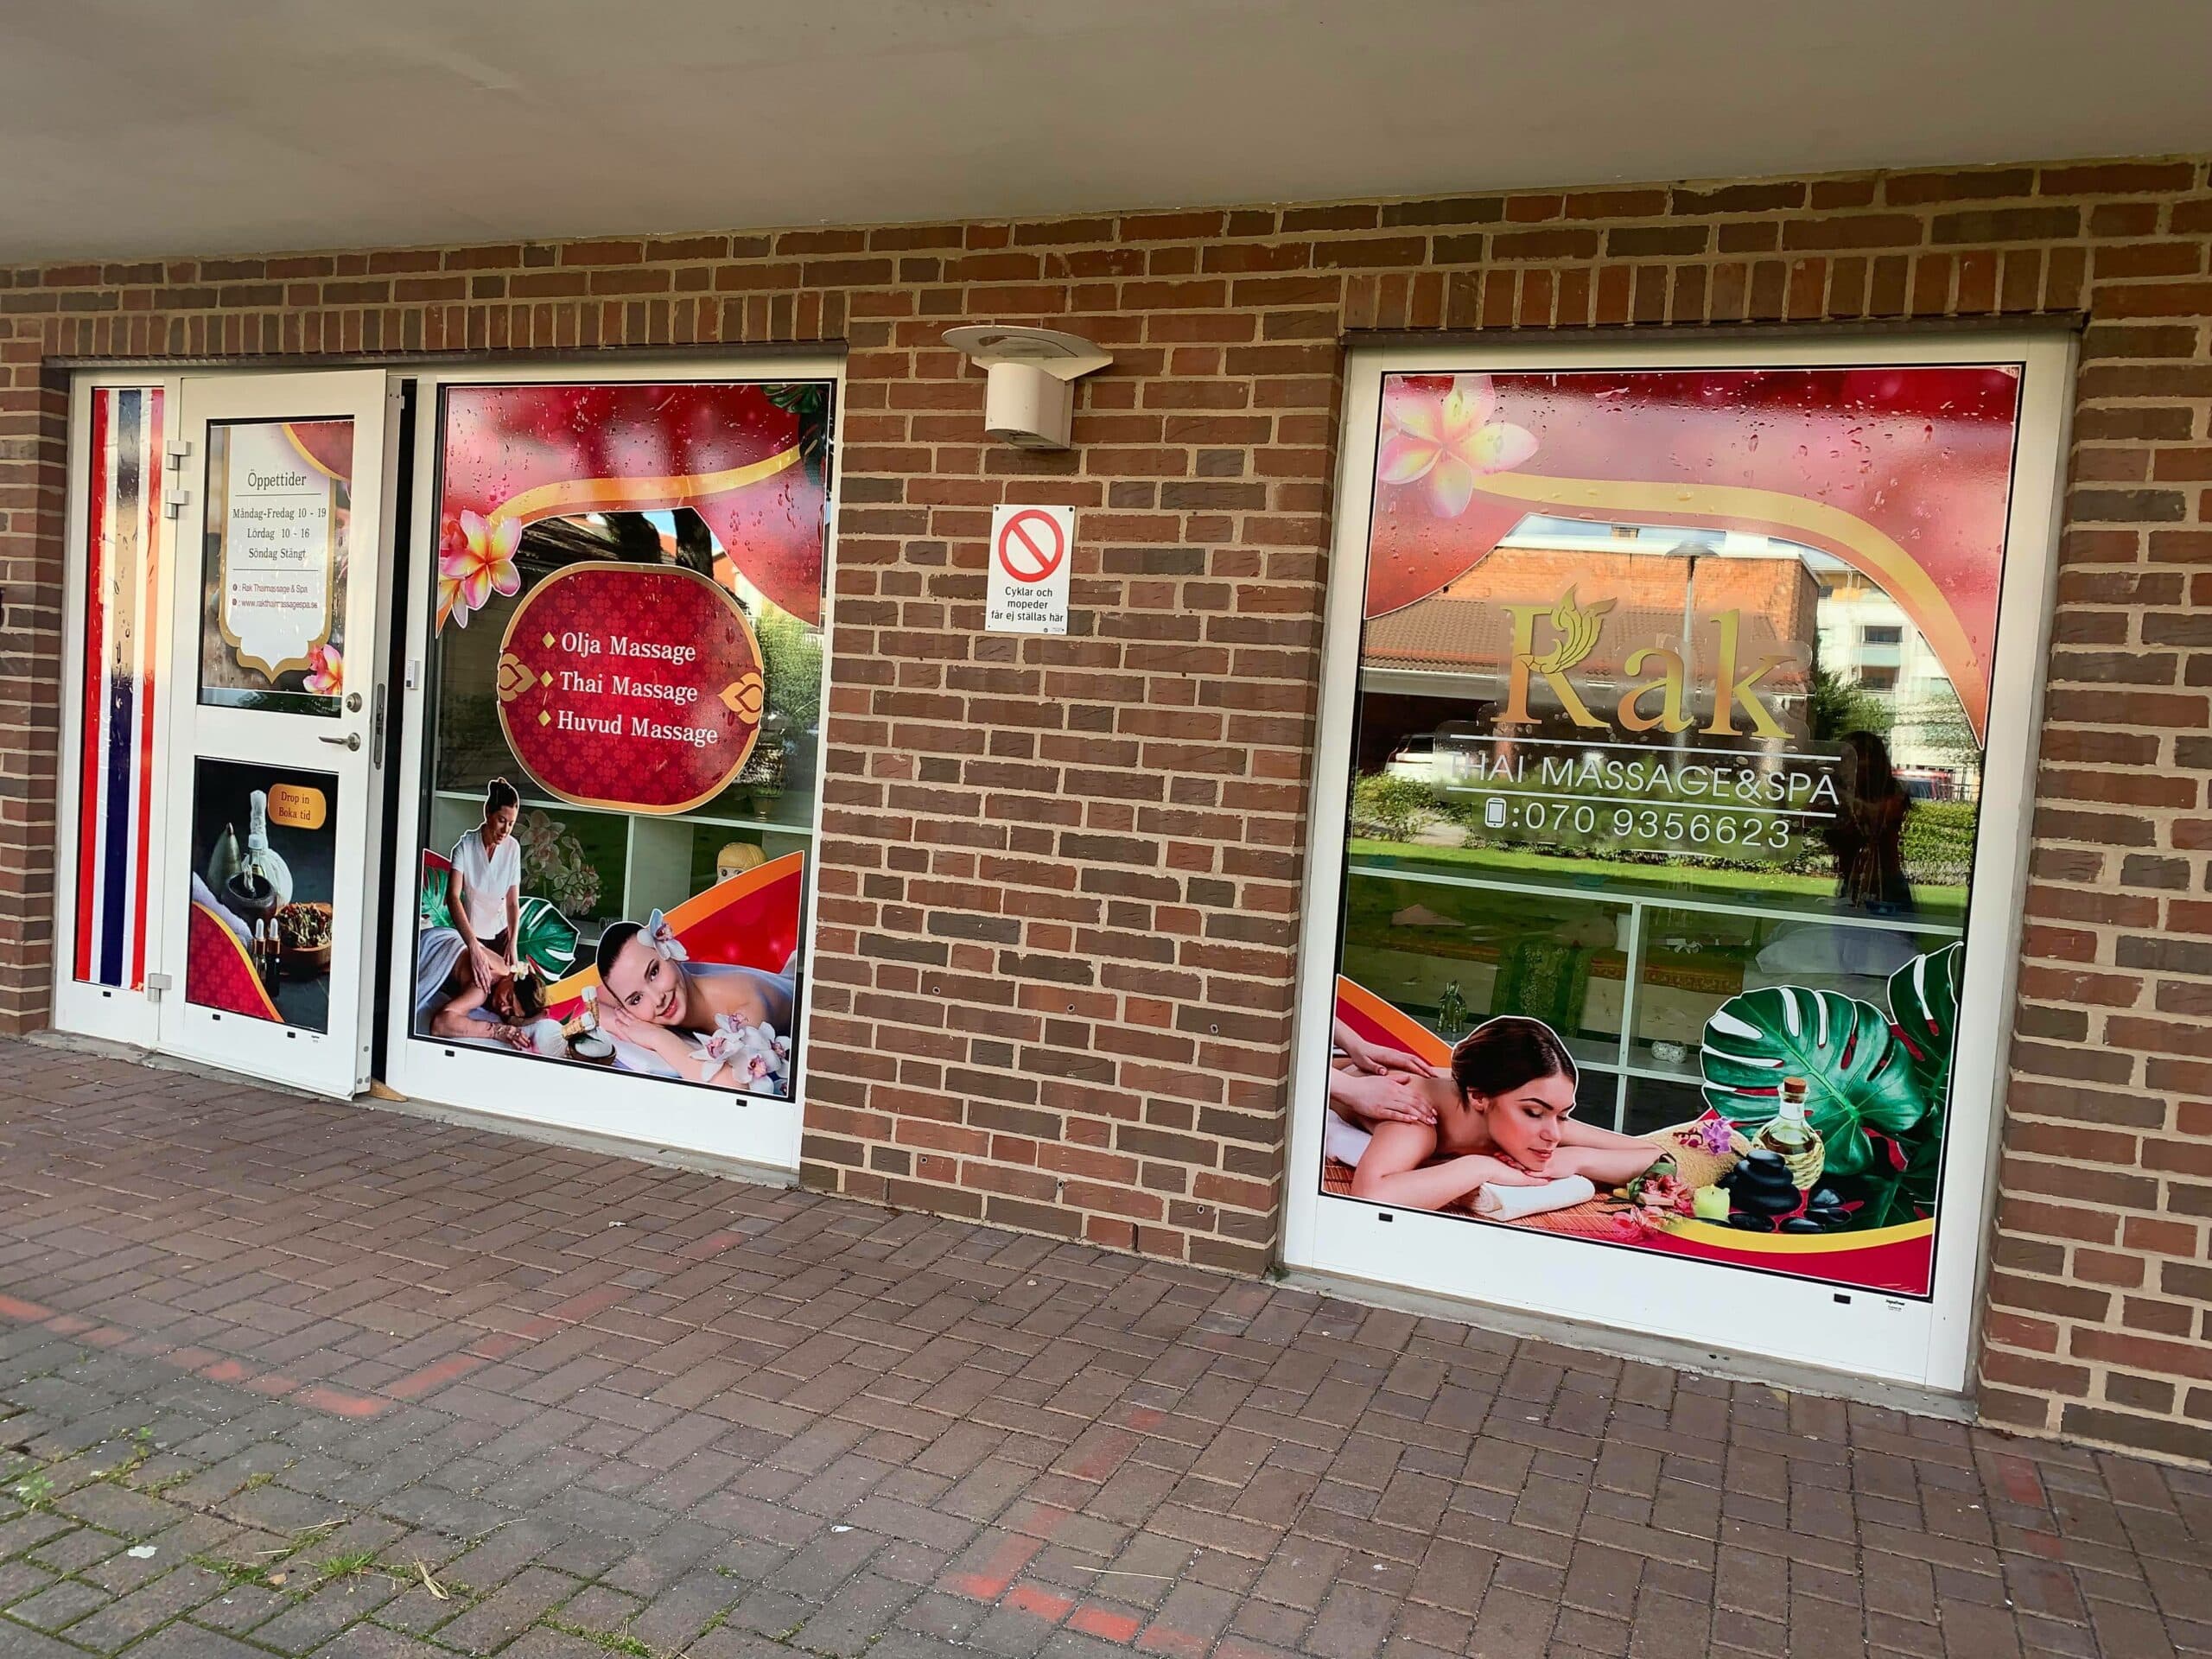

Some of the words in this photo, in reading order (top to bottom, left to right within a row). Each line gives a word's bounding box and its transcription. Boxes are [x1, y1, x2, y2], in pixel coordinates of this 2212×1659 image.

[247, 468, 307, 490] Öppettider
[232, 507, 295, 520] Måndag-Fredag
[298, 508, 307, 518] 10
[318, 508, 327, 518] 19
[247, 527, 275, 540] Lördag
[282, 528, 290, 537] 10
[302, 528, 310, 537] 16
[249, 548, 277, 560] Söndag
[280, 548, 306, 561] Stängt
[242, 583, 251, 592] Rak
[296, 584, 308, 594] Spa
[1005, 586, 1033, 597] Cyklar
[1037, 588, 1052, 597] och
[1007, 601, 1048, 610] mopeder
[991, 610, 1003, 620] får
[1006, 611, 1014, 621] ej
[1017, 611, 1046, 621] ställas
[1049, 613, 1064, 622] här
[562, 632, 601, 658] Olja
[609, 635, 696, 665] Massage
[1490, 584, 1797, 740] Rak
[560, 671, 603, 694] Thai
[611, 675, 698, 706] Massage
[557, 710, 623, 735] Huvud
[631, 716, 718, 747] Massage
[1447, 750, 1524, 784] THAI
[281, 791, 300, 804] Drop
[302, 793, 309, 804] in
[278, 806, 297, 818] Boka
[300, 810, 311, 821] tid
[1612, 807, 1790, 849] 9356623
